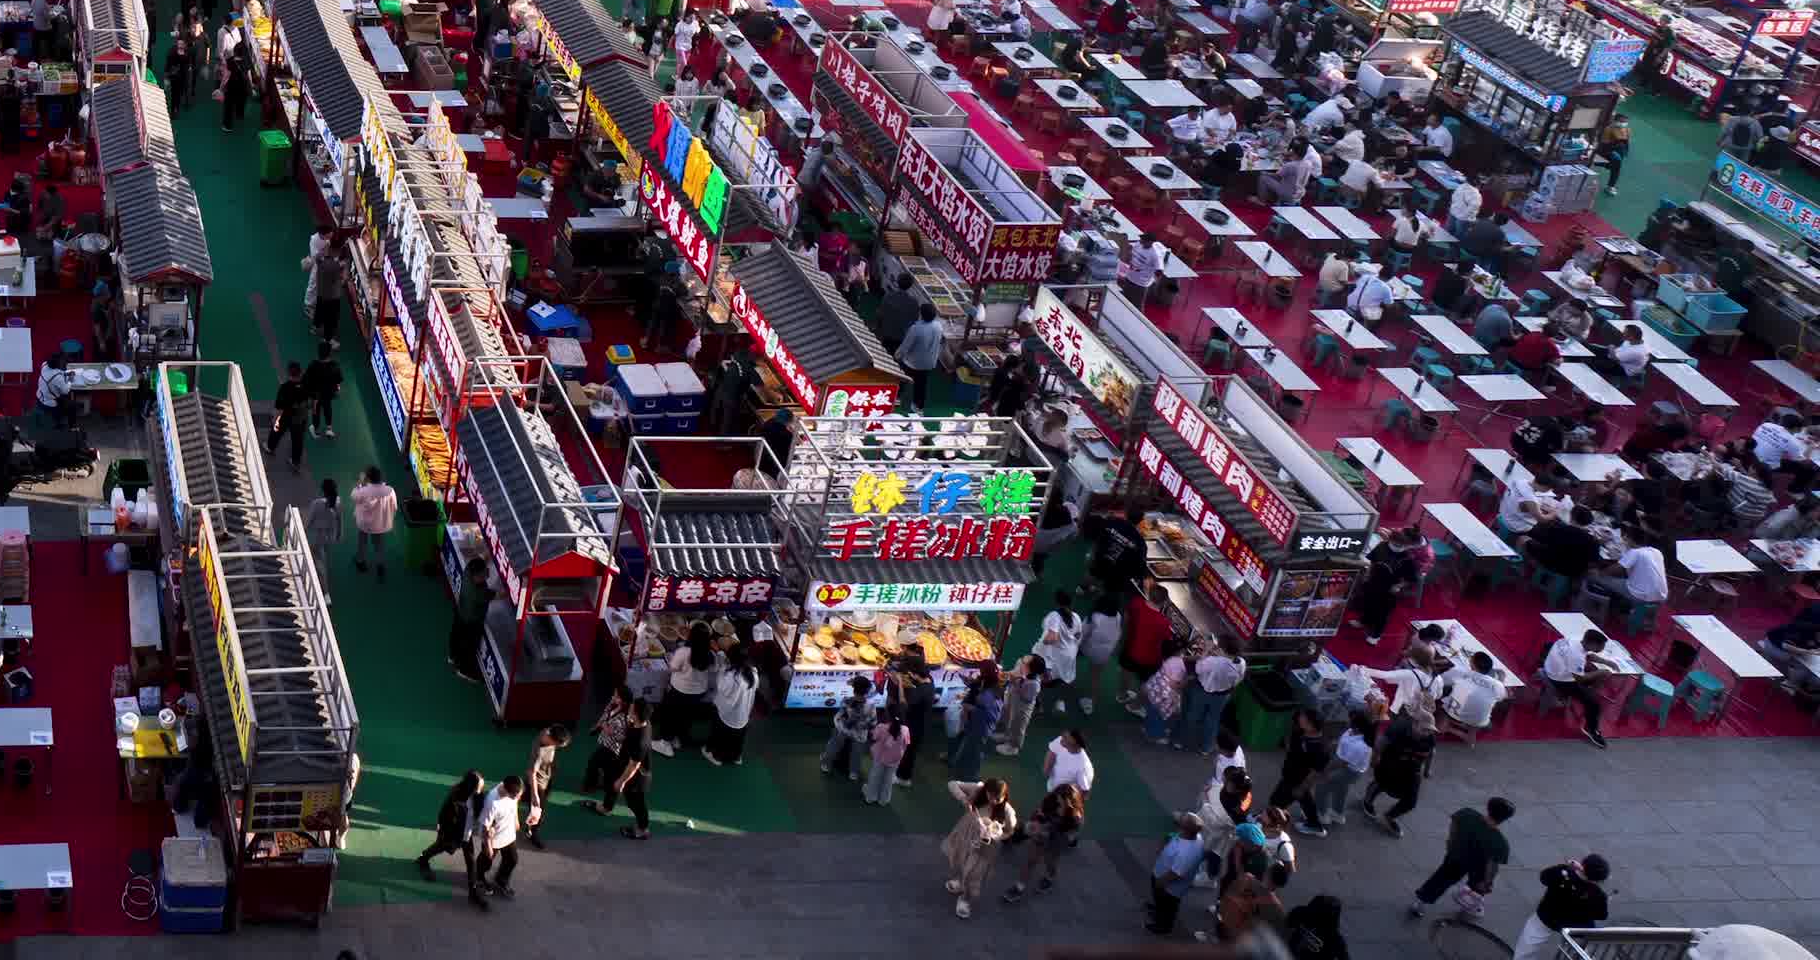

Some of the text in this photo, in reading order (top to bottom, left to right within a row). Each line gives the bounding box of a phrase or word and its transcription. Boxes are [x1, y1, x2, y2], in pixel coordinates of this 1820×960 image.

[899, 137, 988, 255] 东北大馅水饺
[898, 185, 978, 286] 现包东北大馅水饺
[991, 227, 1057, 249] 现包东北
[984, 252, 1053, 281] 大馅水饺
[1035, 318, 1086, 378] 锅包肉
[1048, 305, 1083, 350] 东北
[849, 389, 893, 407] 铁板
[1154, 382, 1254, 502] 秘制烤肉
[850, 470, 1038, 516] 钵仔糕
[1138, 436, 1227, 547] 秘制烤肉
[826, 517, 1039, 562] 手搓冰粉
[1299, 535, 1351, 551] 安全出口
[676, 579, 772, 604] 卷凉皮
[855, 583, 941, 604] 手搓冰粉
[948, 583, 1013, 604] 钵仔糕
